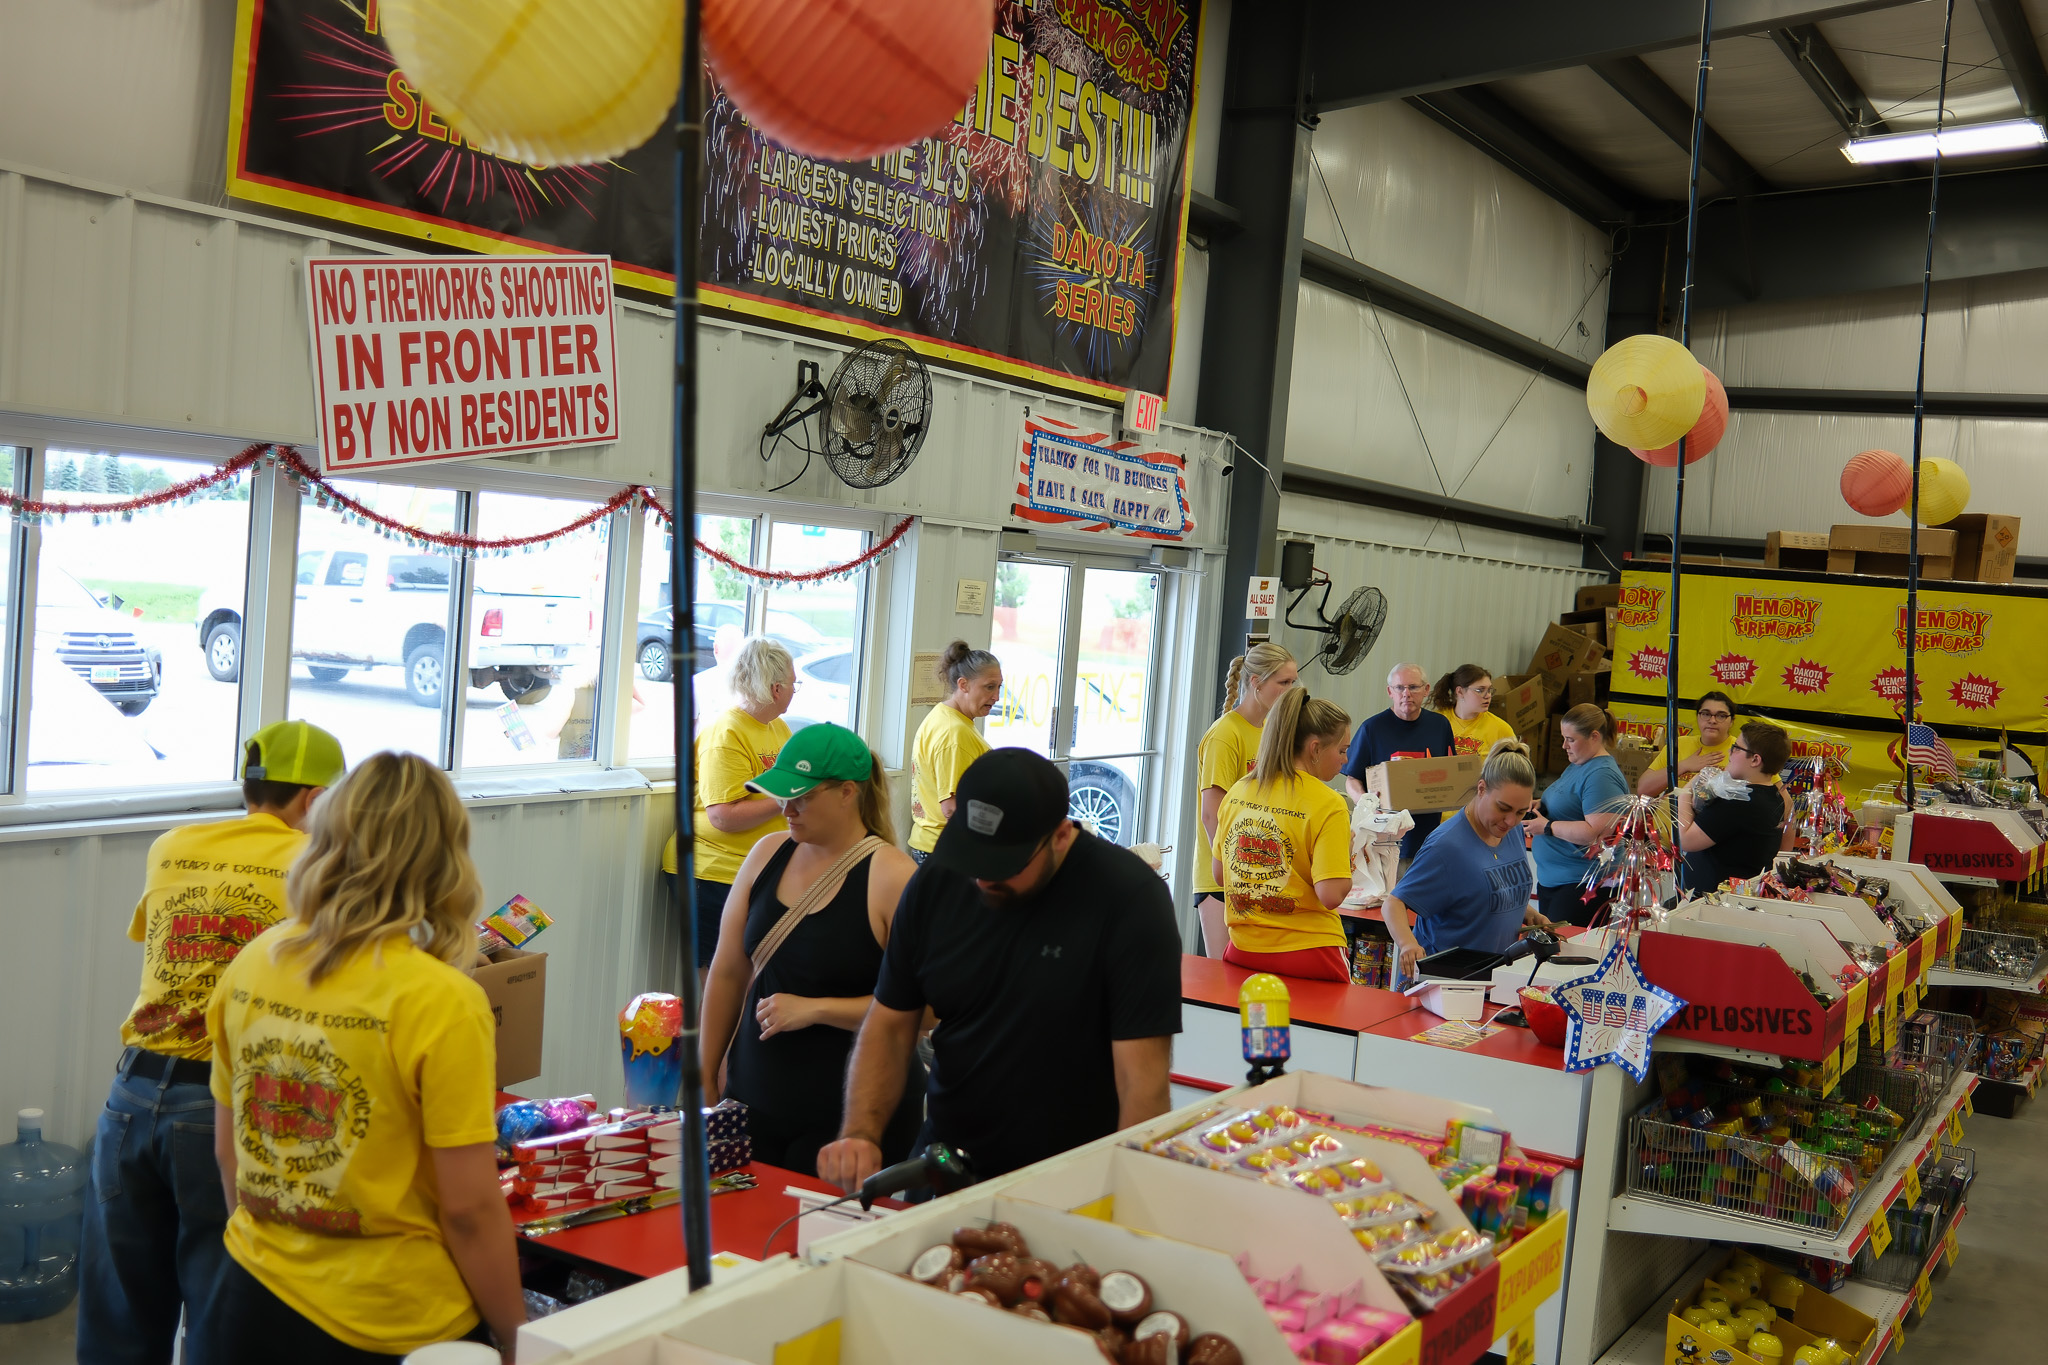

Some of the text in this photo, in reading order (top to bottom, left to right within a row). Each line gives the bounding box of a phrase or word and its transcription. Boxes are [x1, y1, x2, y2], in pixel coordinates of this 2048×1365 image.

[1027, 52, 1155, 208] BEST!!!
[920, 136, 970, 203] 3L'S
[850, 177, 951, 242] SELECTION
[836, 216, 898, 271] PRICES
[1052, 222, 1145, 289] DAKOTA
[319, 264, 605, 325] NO FIREWORKS SHOOTING
[842, 266, 903, 316] OWNED
[1055, 282, 1136, 337] SERIES
[334, 323, 602, 392] IN FRONTIER
[333, 383, 610, 462] BY NON RESIDENTS
[1135, 394, 1160, 432] EXIT
[1037, 445, 1077, 471] THANKS
[1083, 455, 1101, 476] FOR
[1123, 468, 1169, 493] BUSINESS
[1037, 478, 1065, 501] HAVE
[1070, 486, 1076, 502] A
[1081, 487, 1105, 509] SAFE
[1113, 498, 1150, 520] HAPPY
[1250, 593, 1275, 605] ALL SALES
[1254, 606, 1268, 617] FINAL
[1735, 594, 1823, 623] MEMORY
[1732, 615, 1815, 639] FIREWORKS
[1638, 653, 1667, 666] DAKOTA
[1638, 662, 1664, 675] SERIES
[1716, 662, 1750, 672] MEMORY
[1720, 670, 1746, 680] SERIES
[1793, 666, 1824, 681] DAKOTA
[1793, 675, 1820, 688] SERIES
[1961, 681, 1993, 696] DAKOTA
[1961, 690, 1990, 704] SERIES
[1271, 807, 1307, 819] EXPERIENCE
[174, 858, 210, 870] YEARS
[213, 862, 229, 872] OF
[1484, 859, 1533, 892] DAKOTA
[1924, 852, 2015, 868] EXPLOSIVES
[1232, 881, 1251, 889] HOME
[1265, 884, 1281, 893] THE
[268, 1000, 302, 1022] YEARS
[305, 1011, 319, 1025] OF
[323, 1014, 391, 1034] EXPERIENCE
[1582, 987, 1648, 1034] USA
[1500, 1238, 1563, 1313] EXPLOSIVES
